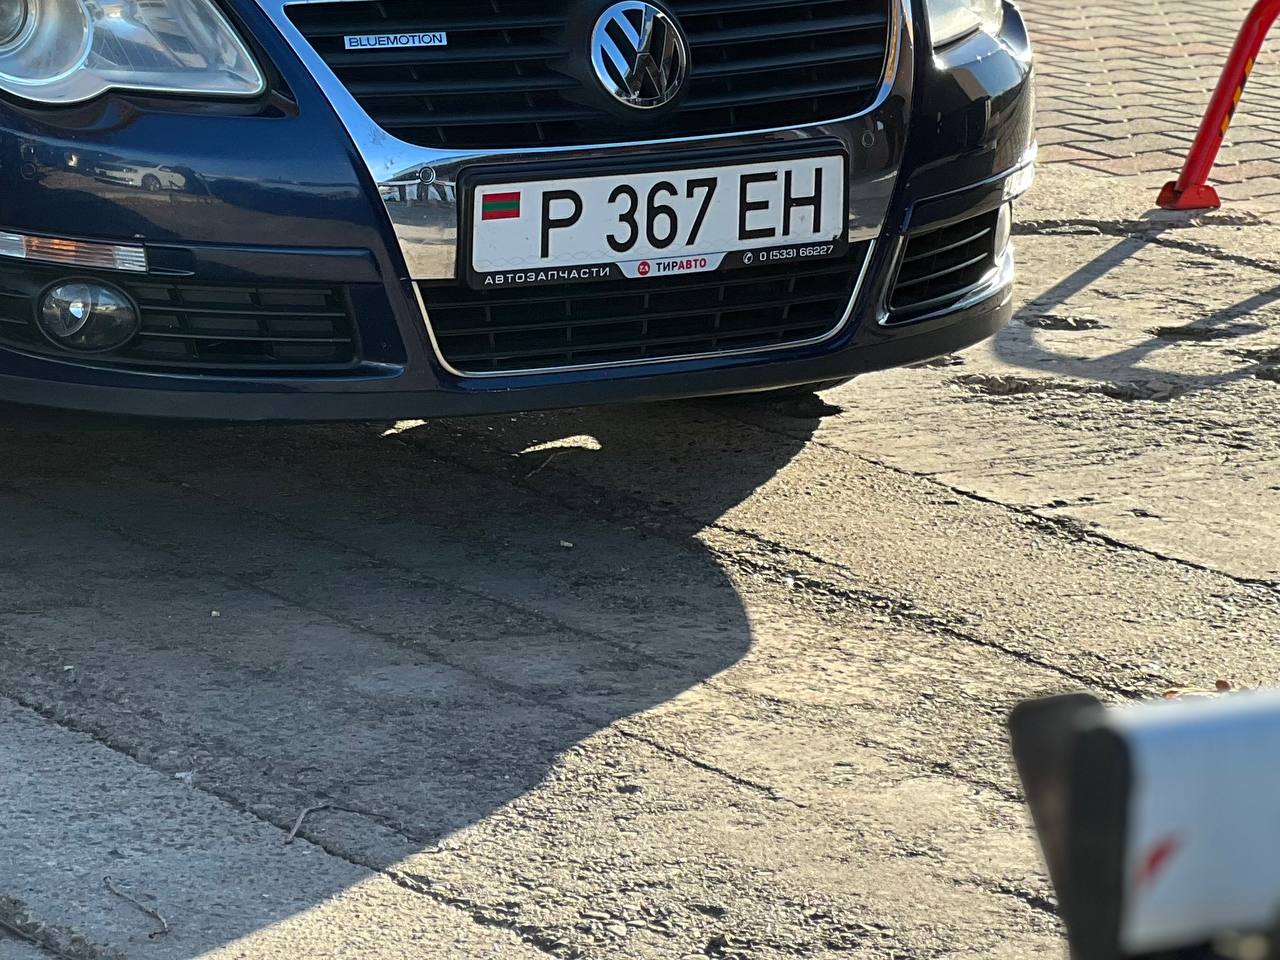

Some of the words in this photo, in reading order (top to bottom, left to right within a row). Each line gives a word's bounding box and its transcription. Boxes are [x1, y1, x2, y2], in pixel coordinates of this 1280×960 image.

[348, 33, 444, 48] BLUEMOTION
[540, 189, 583, 259] P
[606, 177, 718, 253] 367
[738, 167, 823, 241] EH
[769, 248, 797, 260] (533)
[799, 244, 834, 257] 66227
[655, 257, 707, 272] ТИРАВТО
[484, 267, 610, 285] АВТОЗАПЧАСТИ
